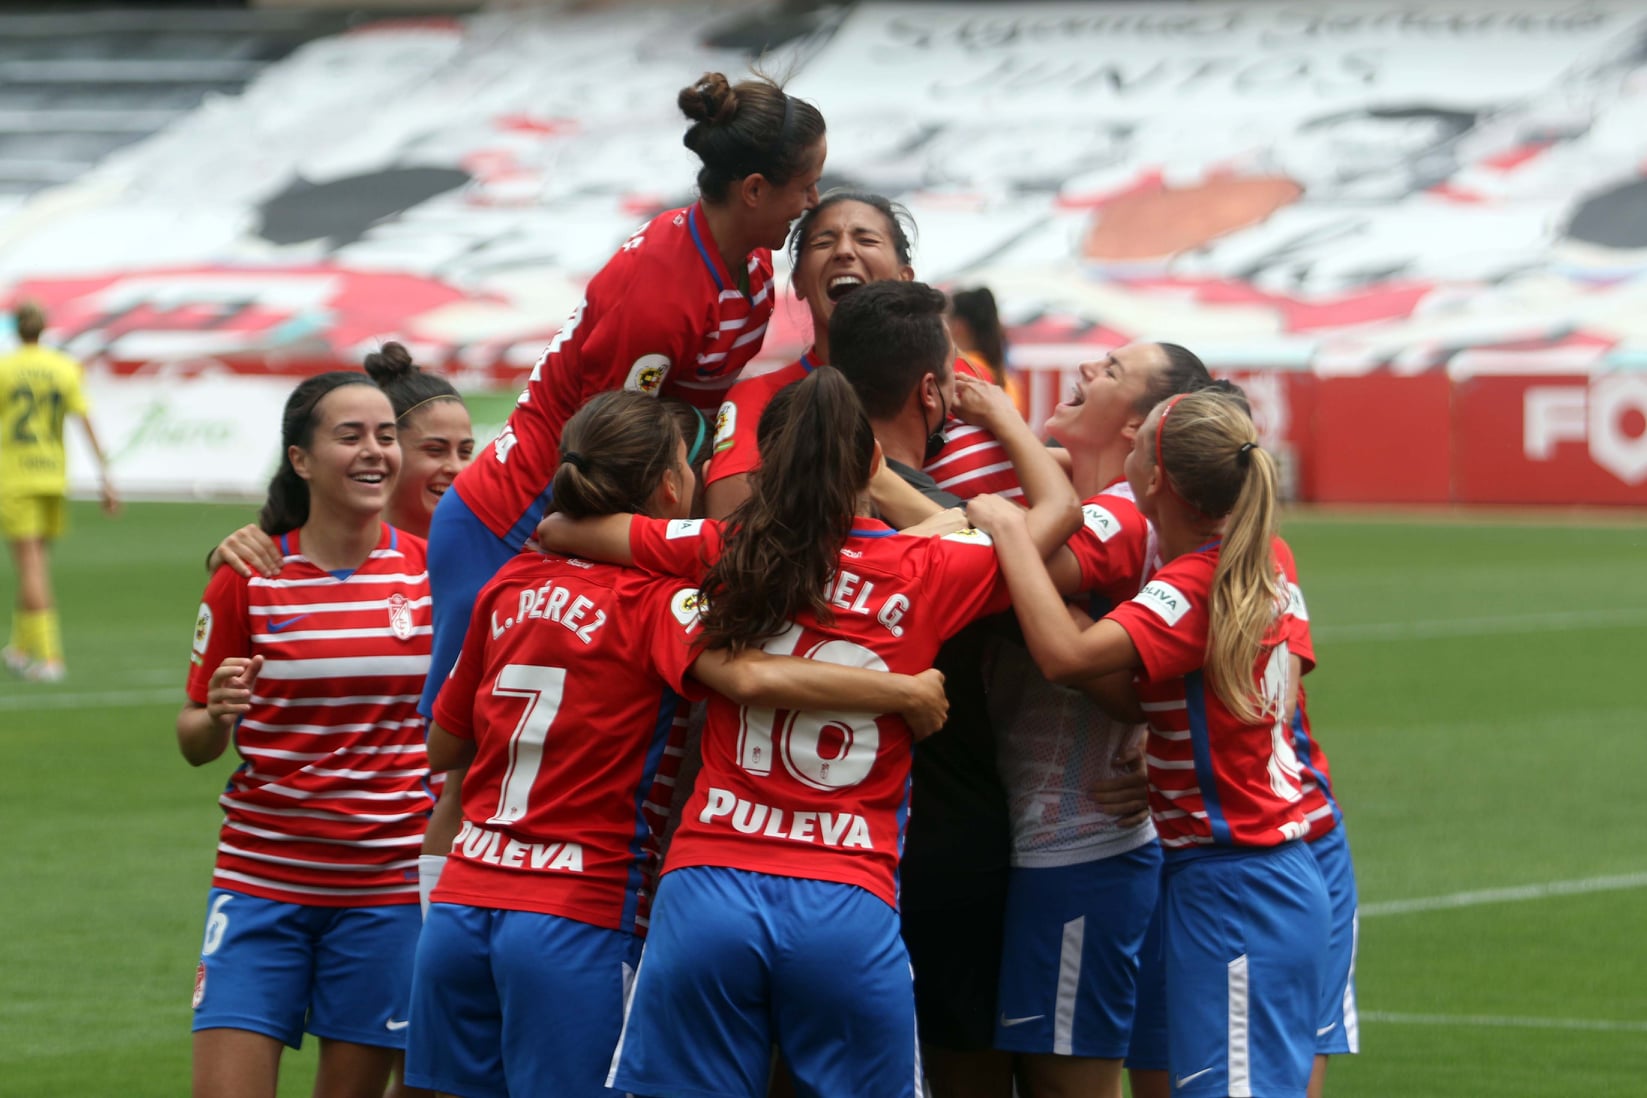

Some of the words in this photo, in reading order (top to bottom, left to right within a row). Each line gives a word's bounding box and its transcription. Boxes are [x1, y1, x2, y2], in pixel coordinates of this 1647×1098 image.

[9, 384, 64, 443] 21
[491, 609, 514, 641] L.
[515, 580, 607, 645] PÉREZ
[877, 593, 911, 638] G.
[486, 663, 567, 825] 7
[451, 820, 584, 872] PULEVA
[699, 787, 875, 849] PULEVA
[202, 893, 234, 956] 6
